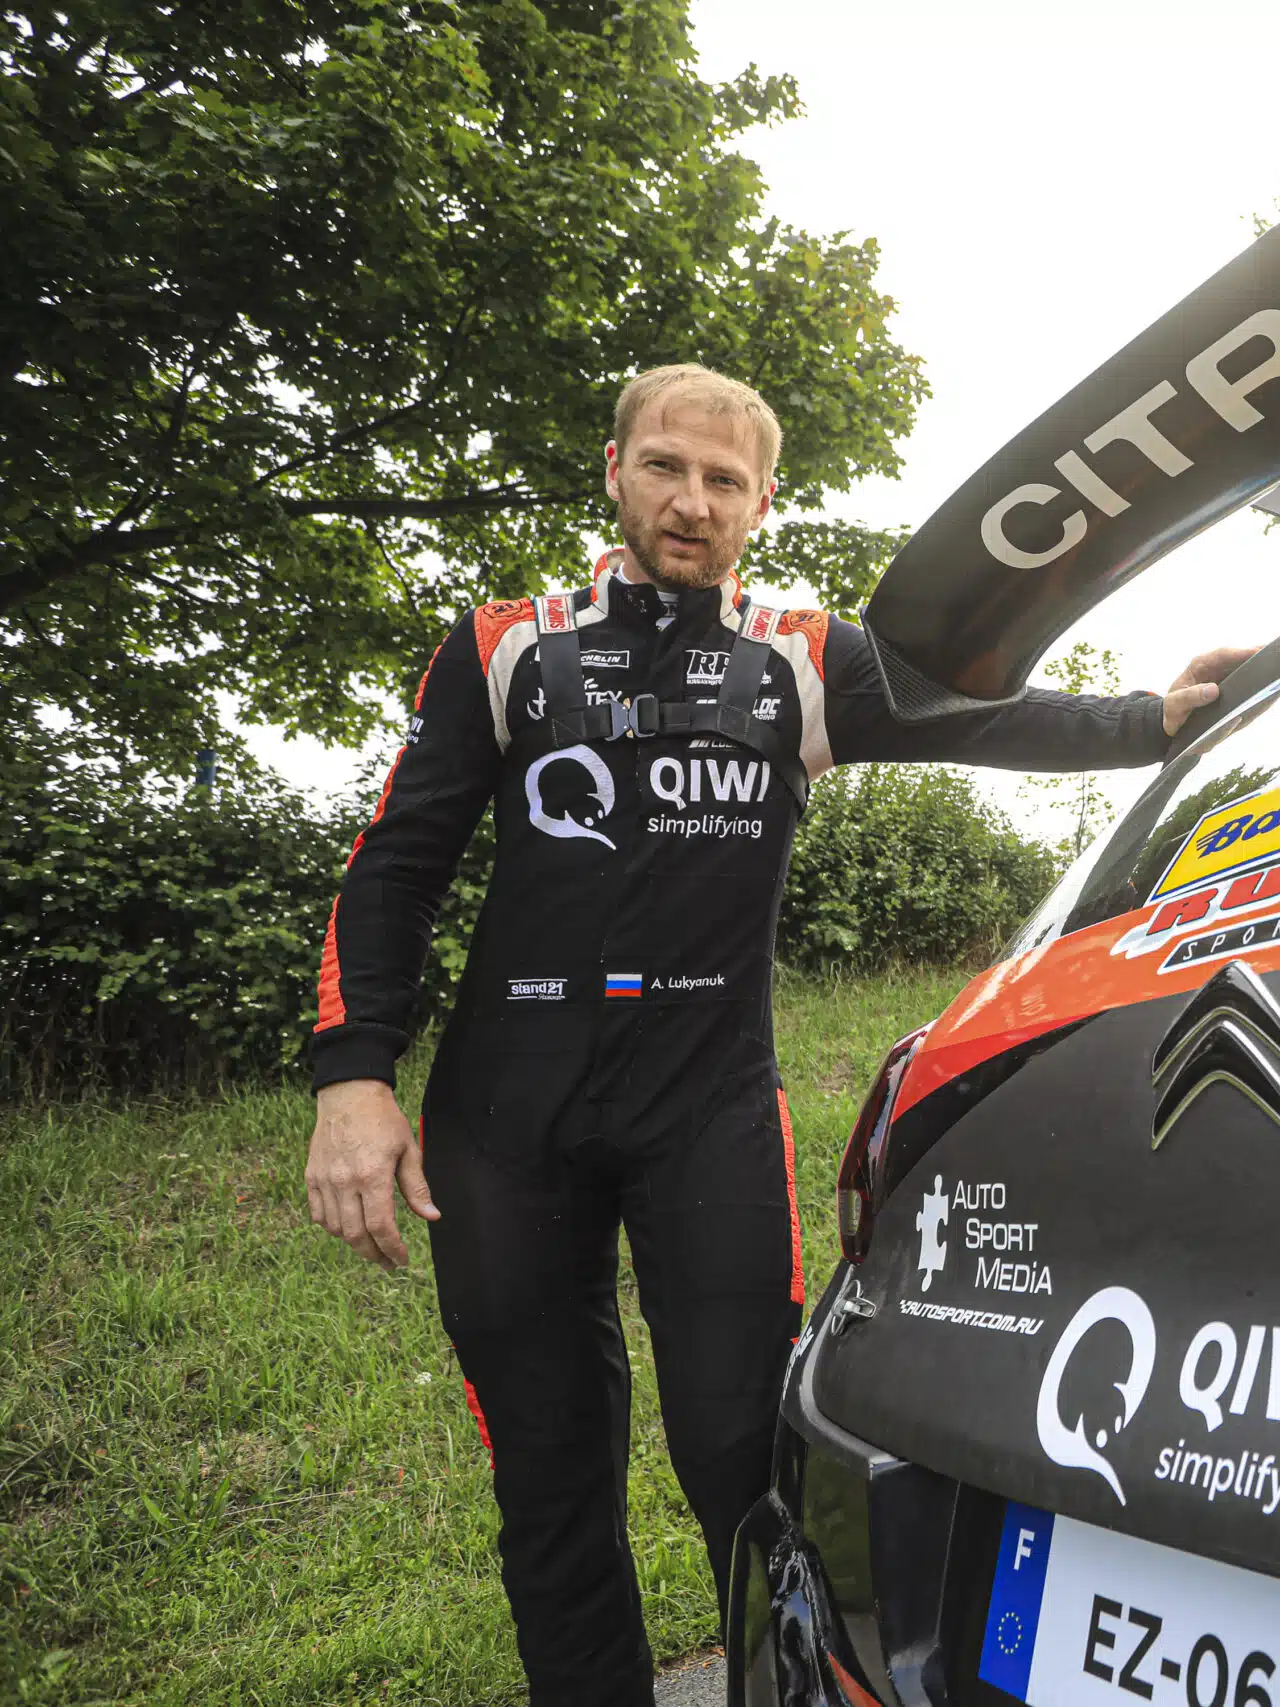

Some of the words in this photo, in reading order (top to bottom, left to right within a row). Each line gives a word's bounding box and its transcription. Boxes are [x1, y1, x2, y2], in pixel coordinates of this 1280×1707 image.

[580, 655, 621, 663] CHELIN
[649, 757, 771, 811] QIWI
[647, 814, 762, 838] simplifying
[650, 977, 664, 989] A.
[668, 973, 725, 991] Lukyanuk
[1013, 1528, 1036, 1570] F
